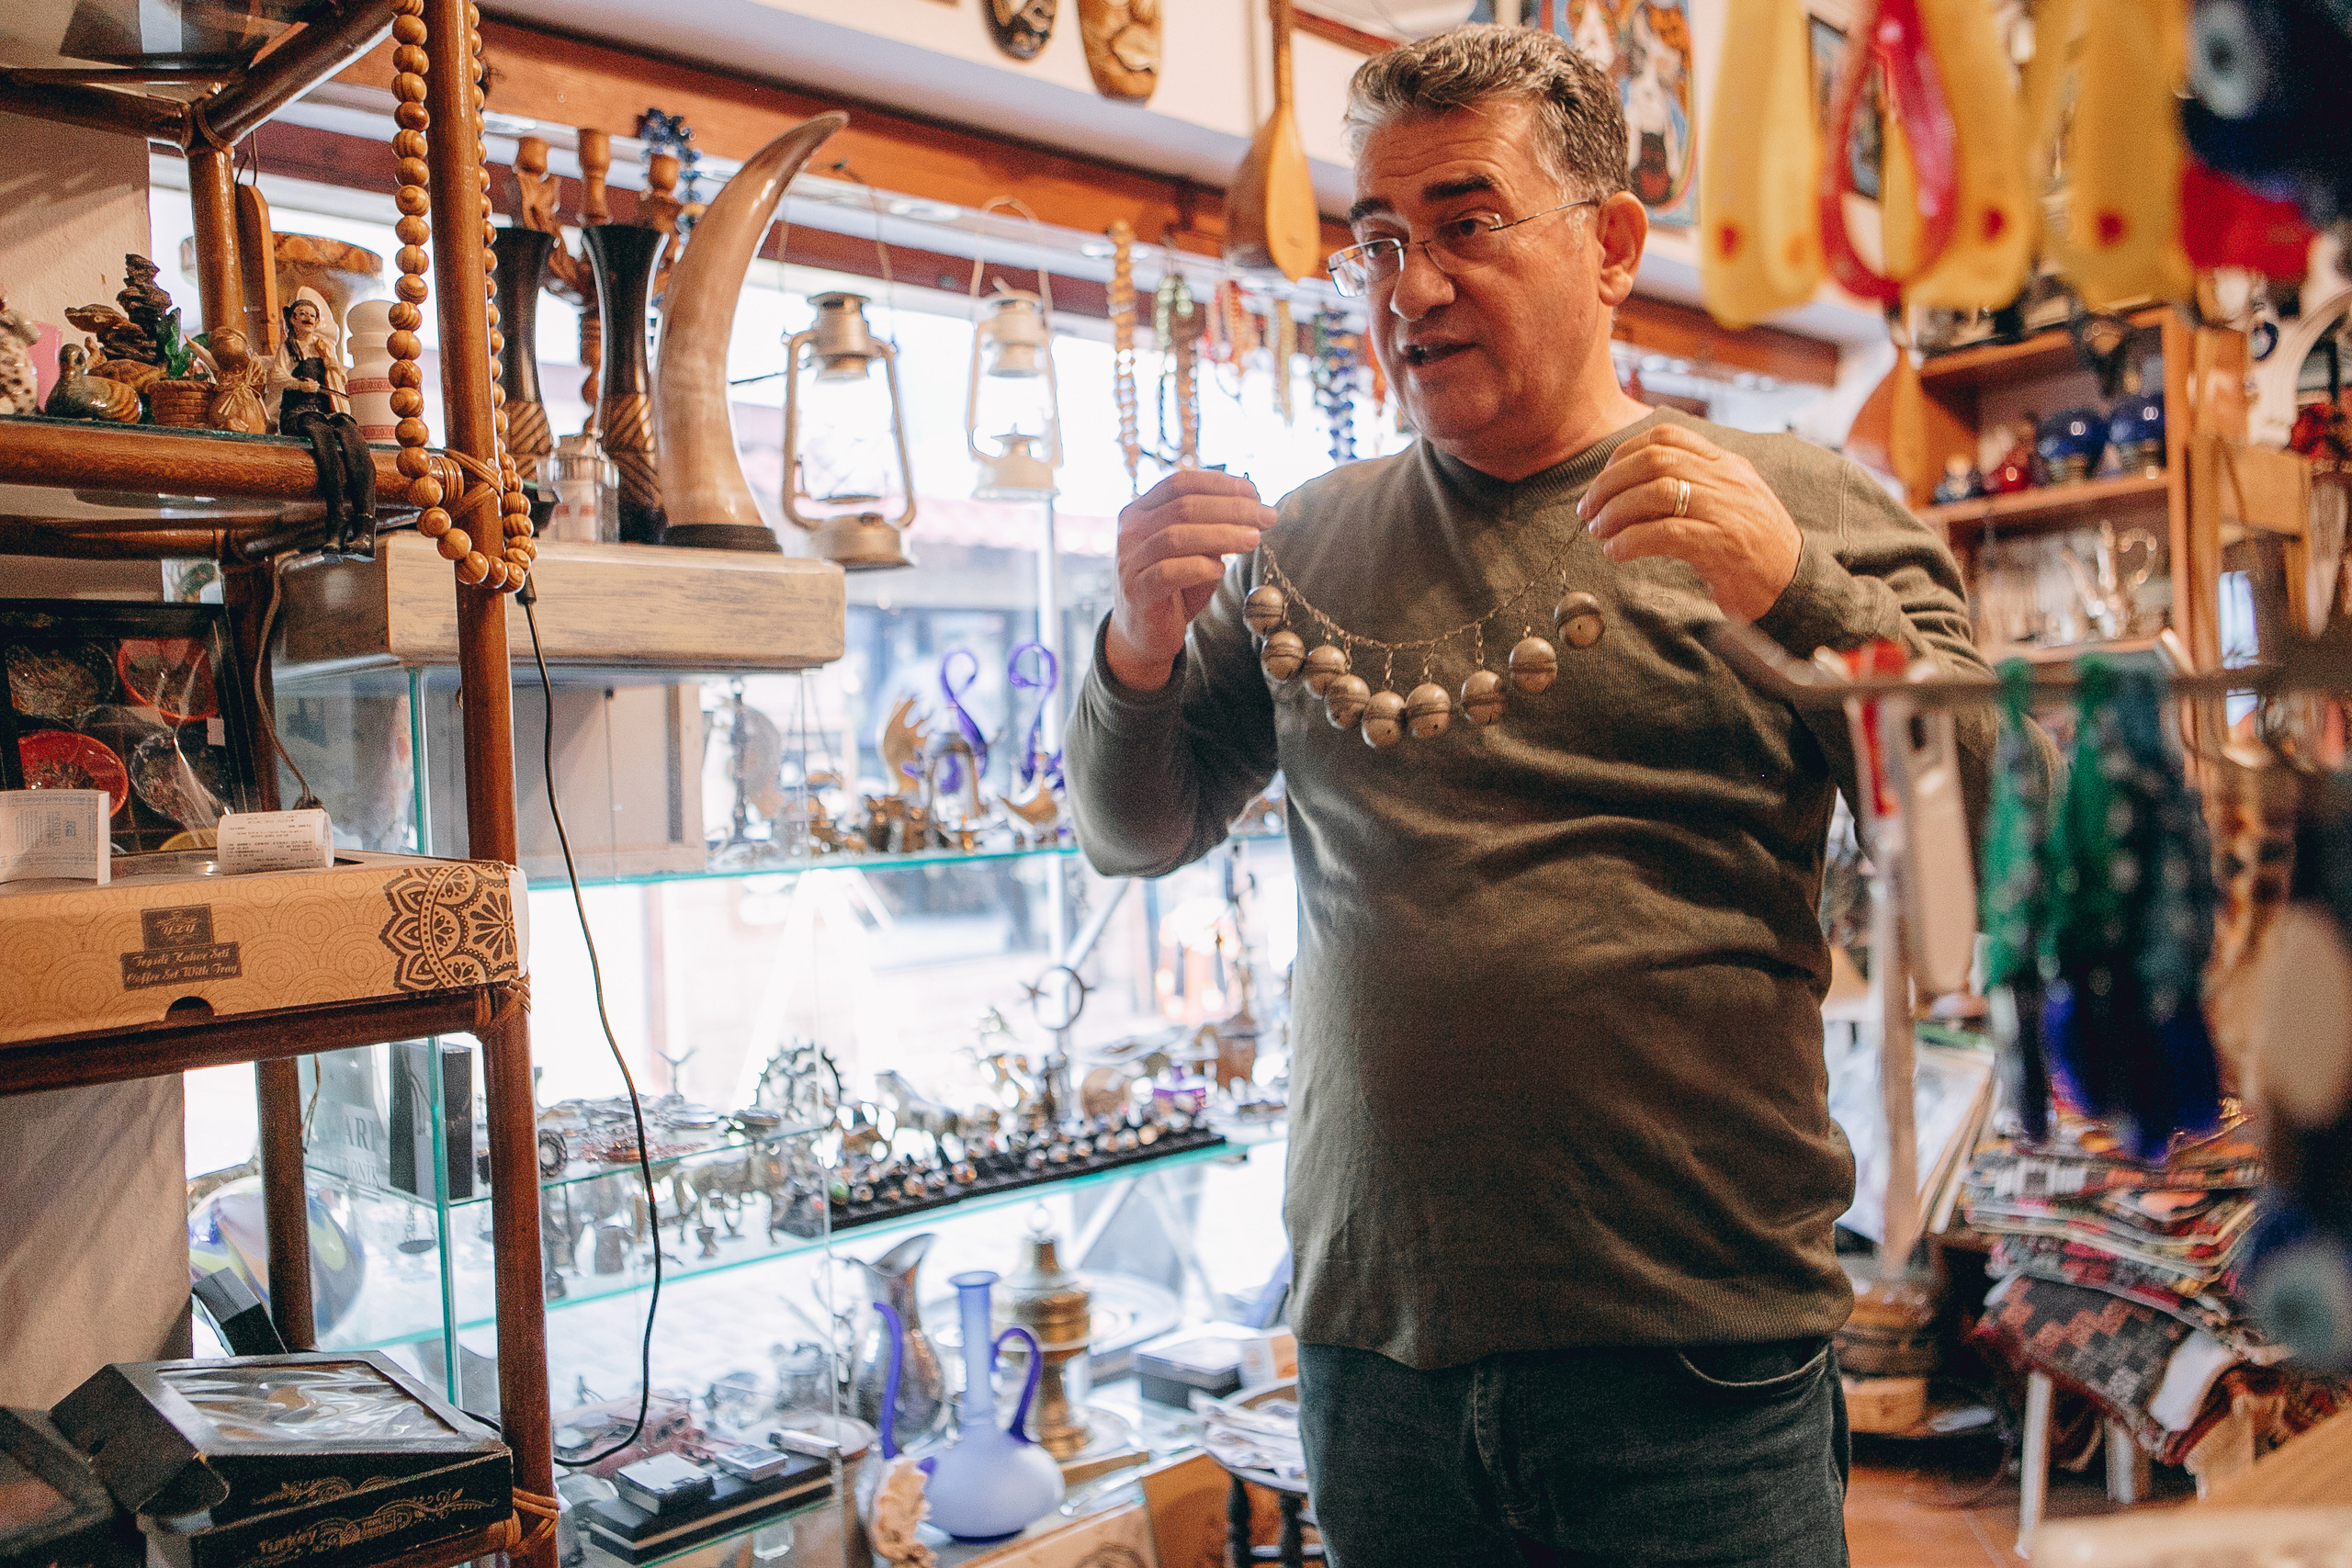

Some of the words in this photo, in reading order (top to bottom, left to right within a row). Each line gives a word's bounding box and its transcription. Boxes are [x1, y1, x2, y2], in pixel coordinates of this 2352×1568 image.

[173, 952, 209, 963] Kahve
[209, 948, 230, 959] Seti
[127, 971, 162, 985] Coffee
[163, 968, 180, 980] Set
[181, 965, 209, 977] With
[211, 963, 238, 975] Tray
